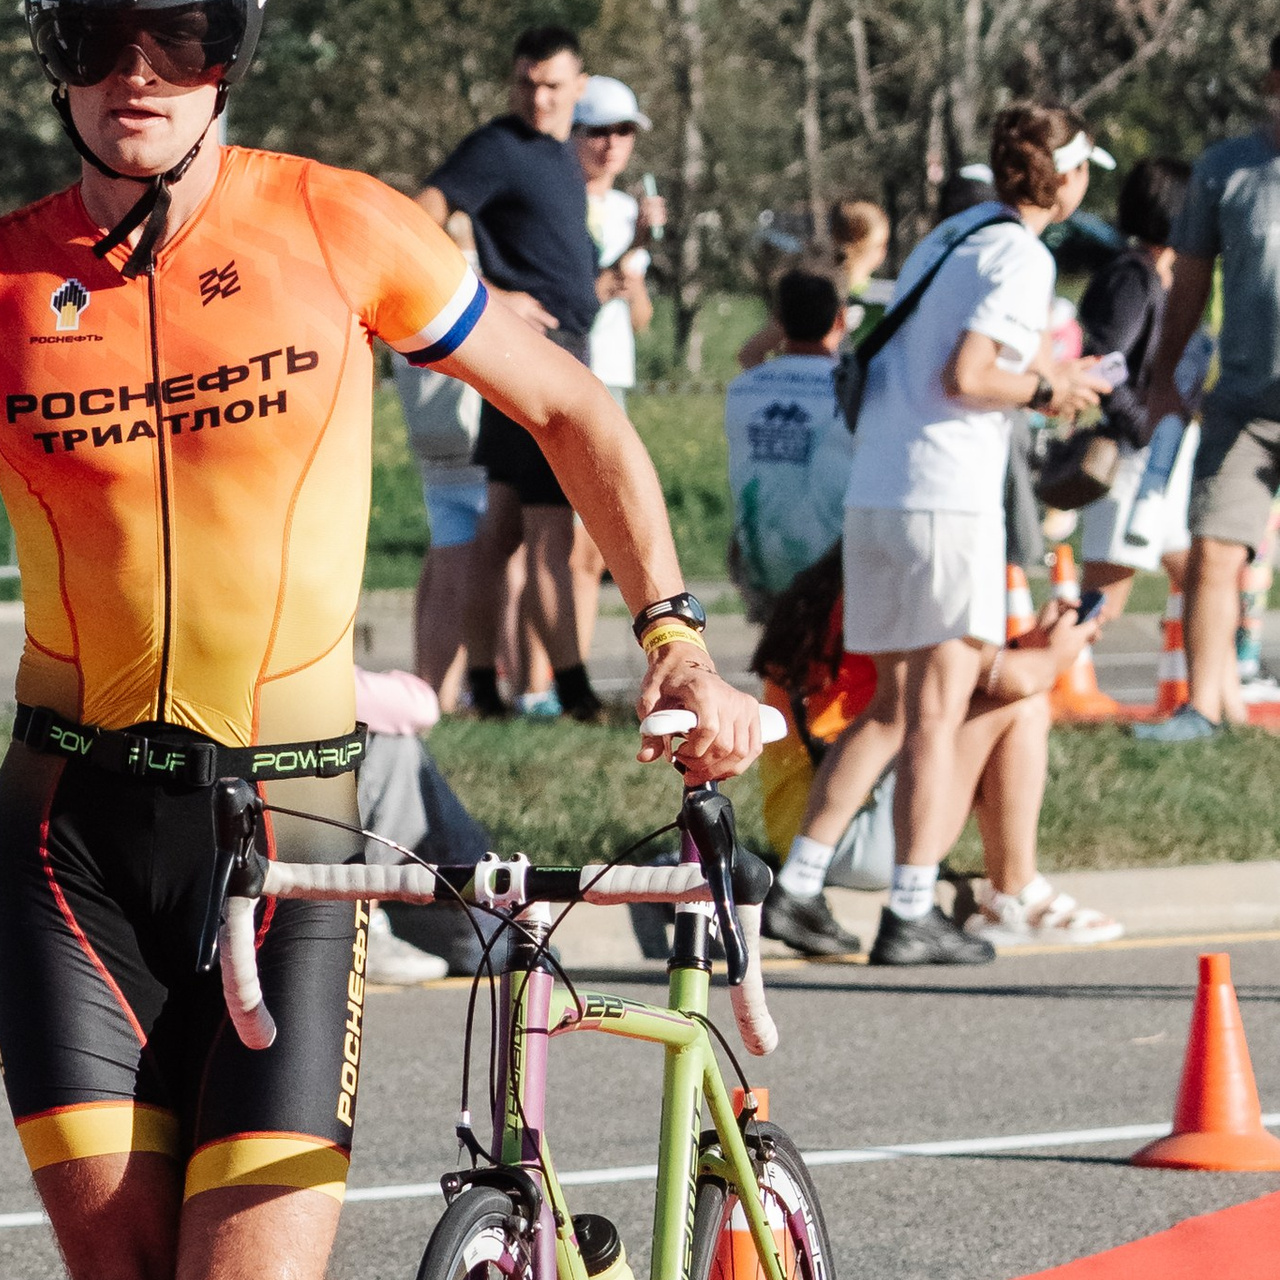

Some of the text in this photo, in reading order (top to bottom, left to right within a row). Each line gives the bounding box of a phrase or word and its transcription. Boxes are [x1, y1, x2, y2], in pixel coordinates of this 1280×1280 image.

[29, 333, 104, 345] РОСНЕФТЬ
[6, 345, 319, 423] РОСНЕФТЬ
[33, 389, 288, 455] ТРИАТЛОН
[337, 899, 370, 1128] РОСНЕФТ
